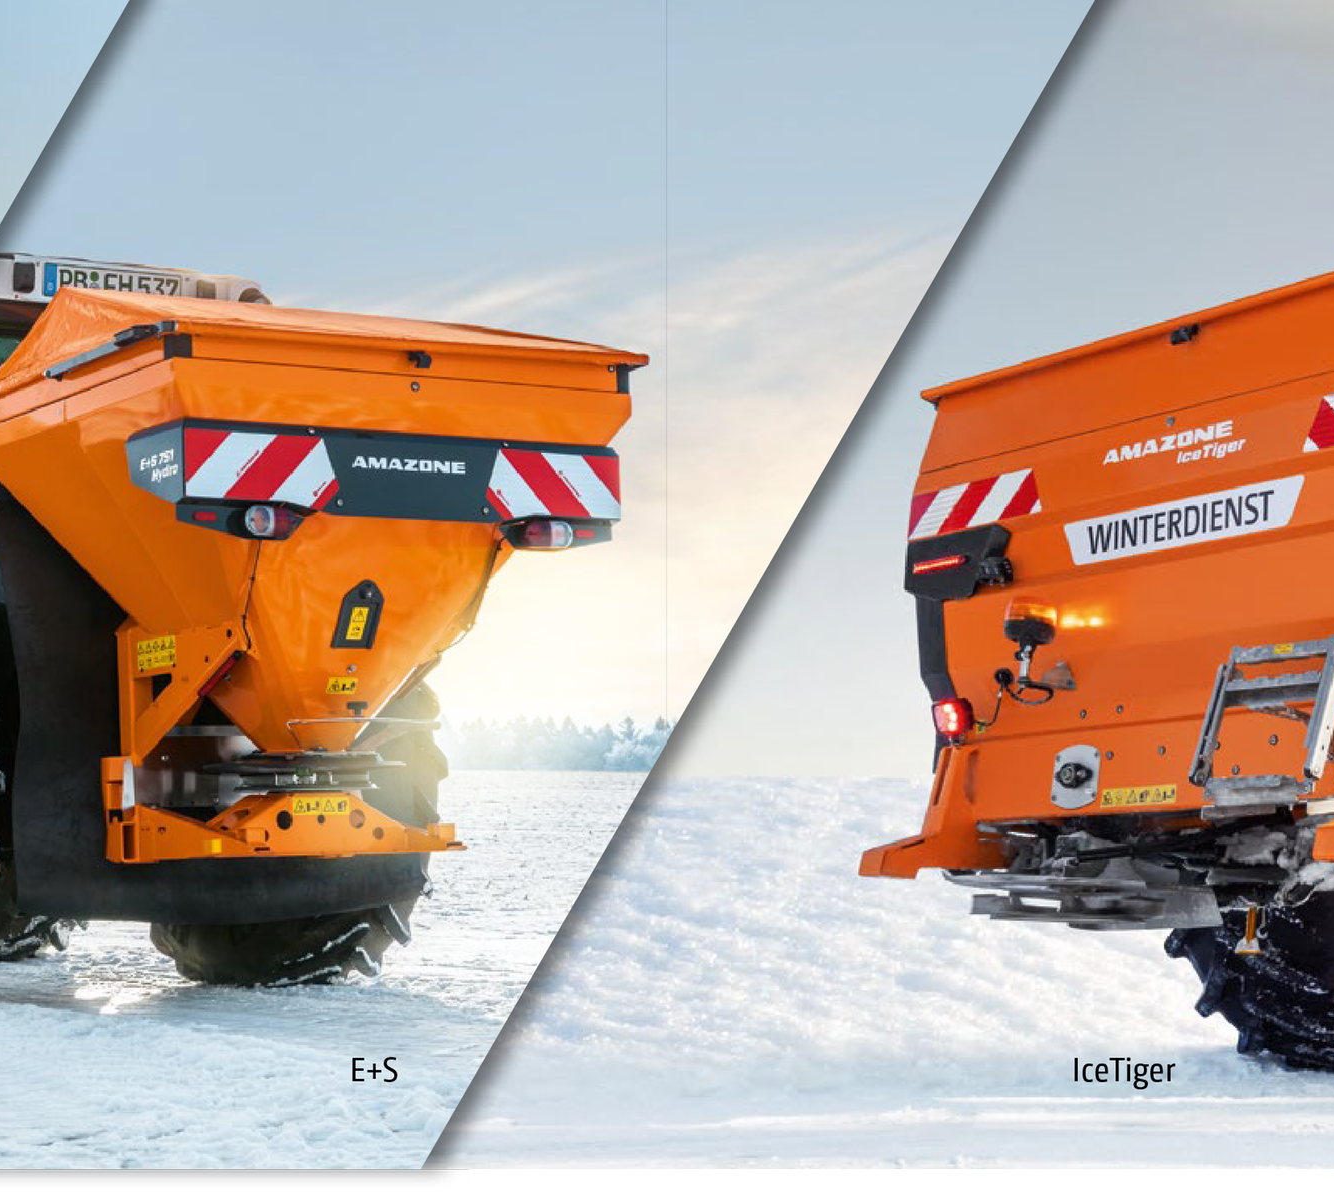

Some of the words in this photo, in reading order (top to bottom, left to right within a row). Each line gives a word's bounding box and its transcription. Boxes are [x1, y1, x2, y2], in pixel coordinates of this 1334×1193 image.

[138, 276, 178, 297] 537
[1103, 420, 1233, 466] AMAZONE
[1176, 439, 1247, 464] IceTiger
[351, 456, 466, 475] AMAZONE
[1087, 490, 1275, 555] WINTERDIENST
